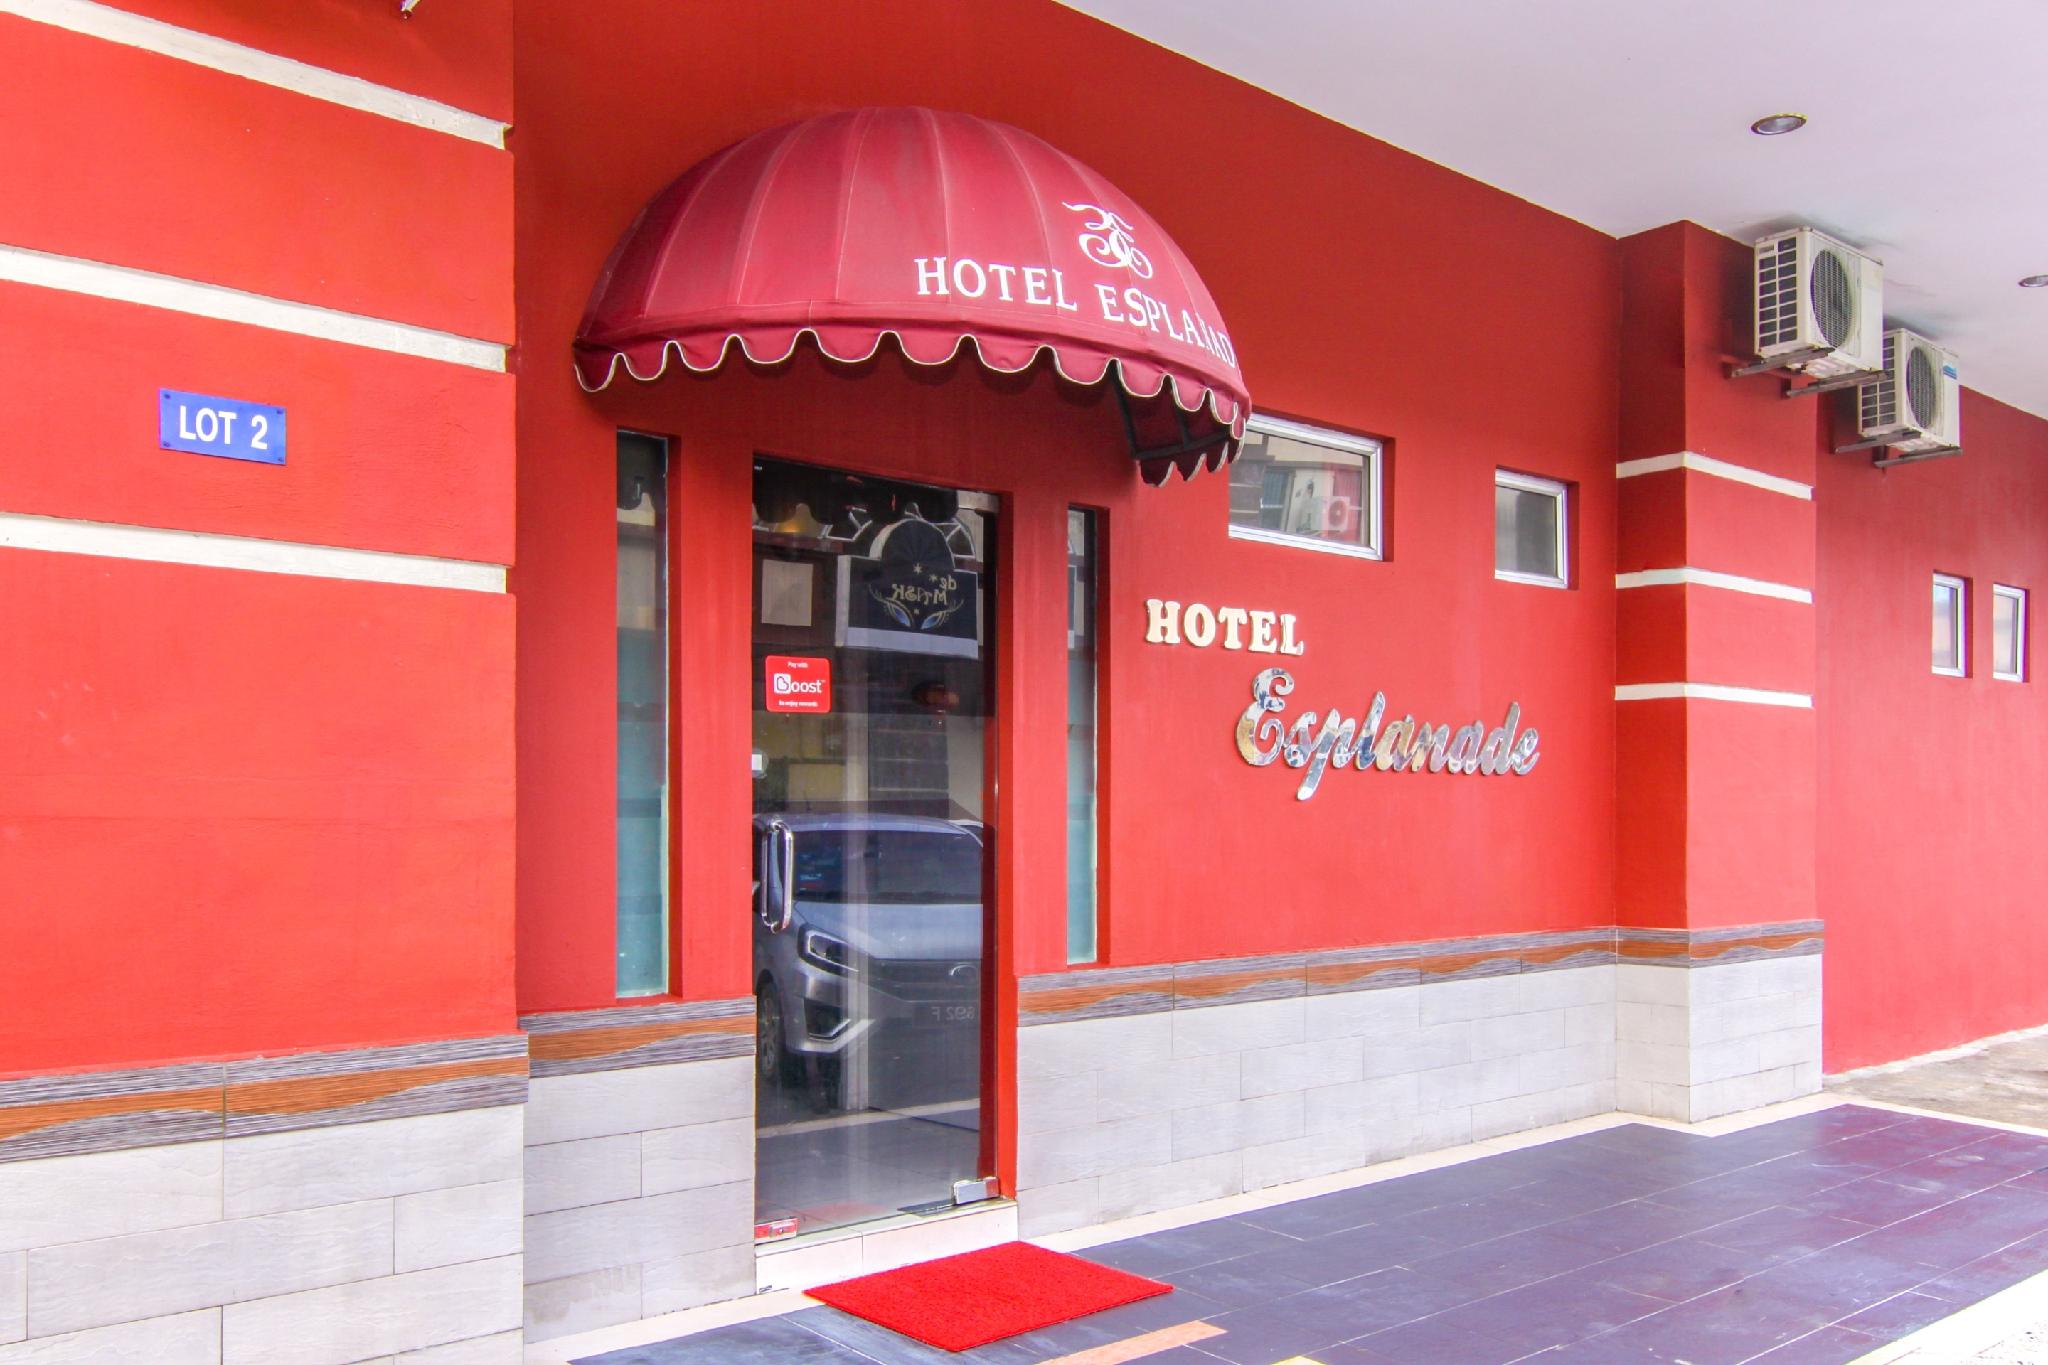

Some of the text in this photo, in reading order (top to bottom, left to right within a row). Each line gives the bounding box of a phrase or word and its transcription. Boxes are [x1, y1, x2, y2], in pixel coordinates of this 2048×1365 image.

[914, 256, 1078, 311] HOTEL
[179, 405, 268, 450] LOT 2
[1145, 598, 1304, 656] HOTEL
[773, 673, 822, 694] Boost
[1235, 667, 1541, 801] Esplanade
